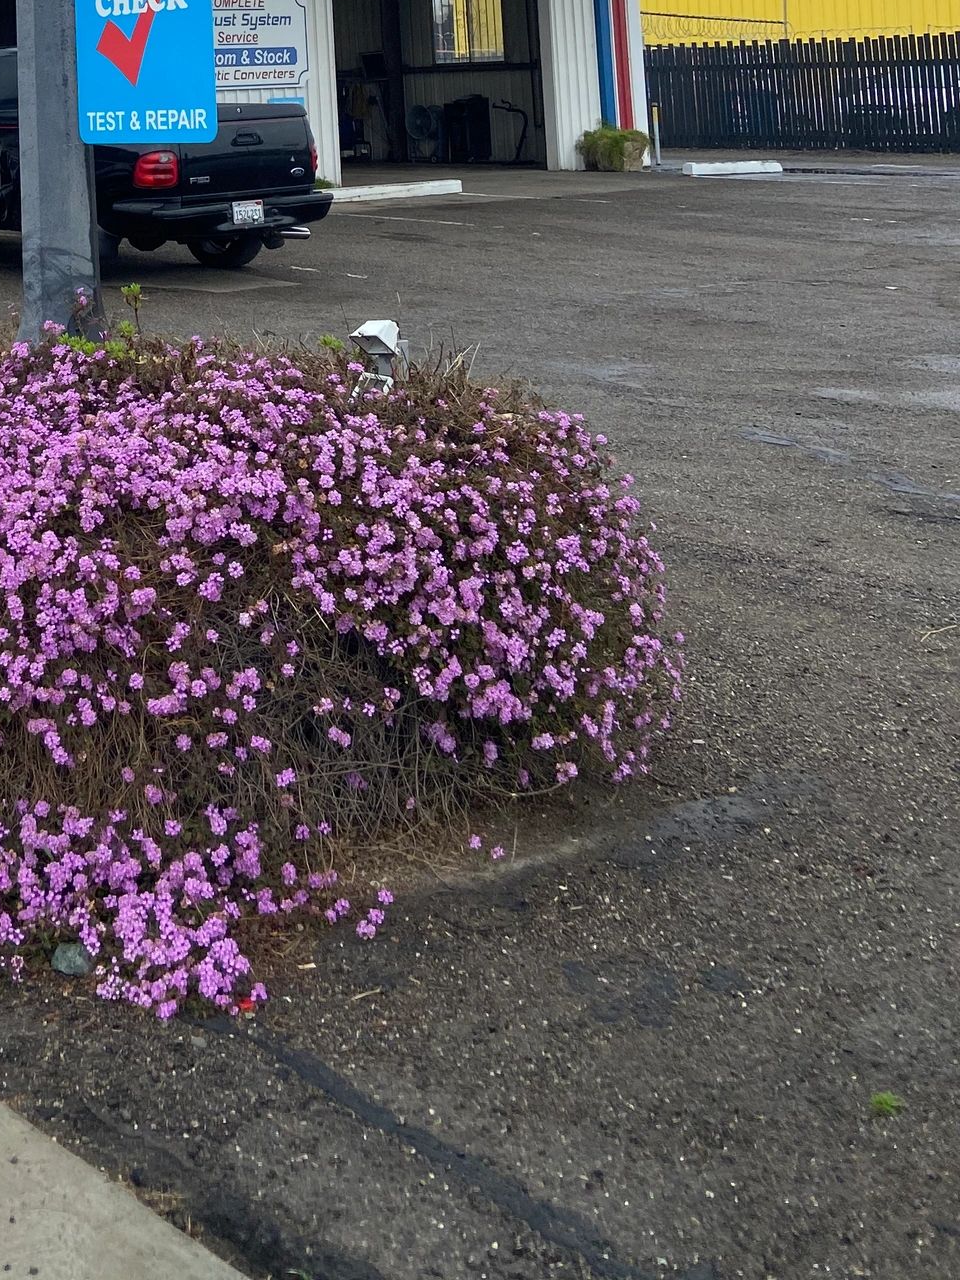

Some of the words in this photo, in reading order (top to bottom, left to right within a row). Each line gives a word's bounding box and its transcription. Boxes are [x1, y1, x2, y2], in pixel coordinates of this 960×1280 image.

[214, 13, 236, 26] ust
[241, 13, 292, 30] System
[218, 31, 258, 42] Service
[240, 50, 250, 64] &
[254, 49, 290, 64] Stock
[216, 70, 230, 80] tic
[234, 69, 295, 80] Converters
[87, 111, 125, 132] TEST
[130, 109, 140, 131] &
[146, 108, 207, 131] REPAIR
